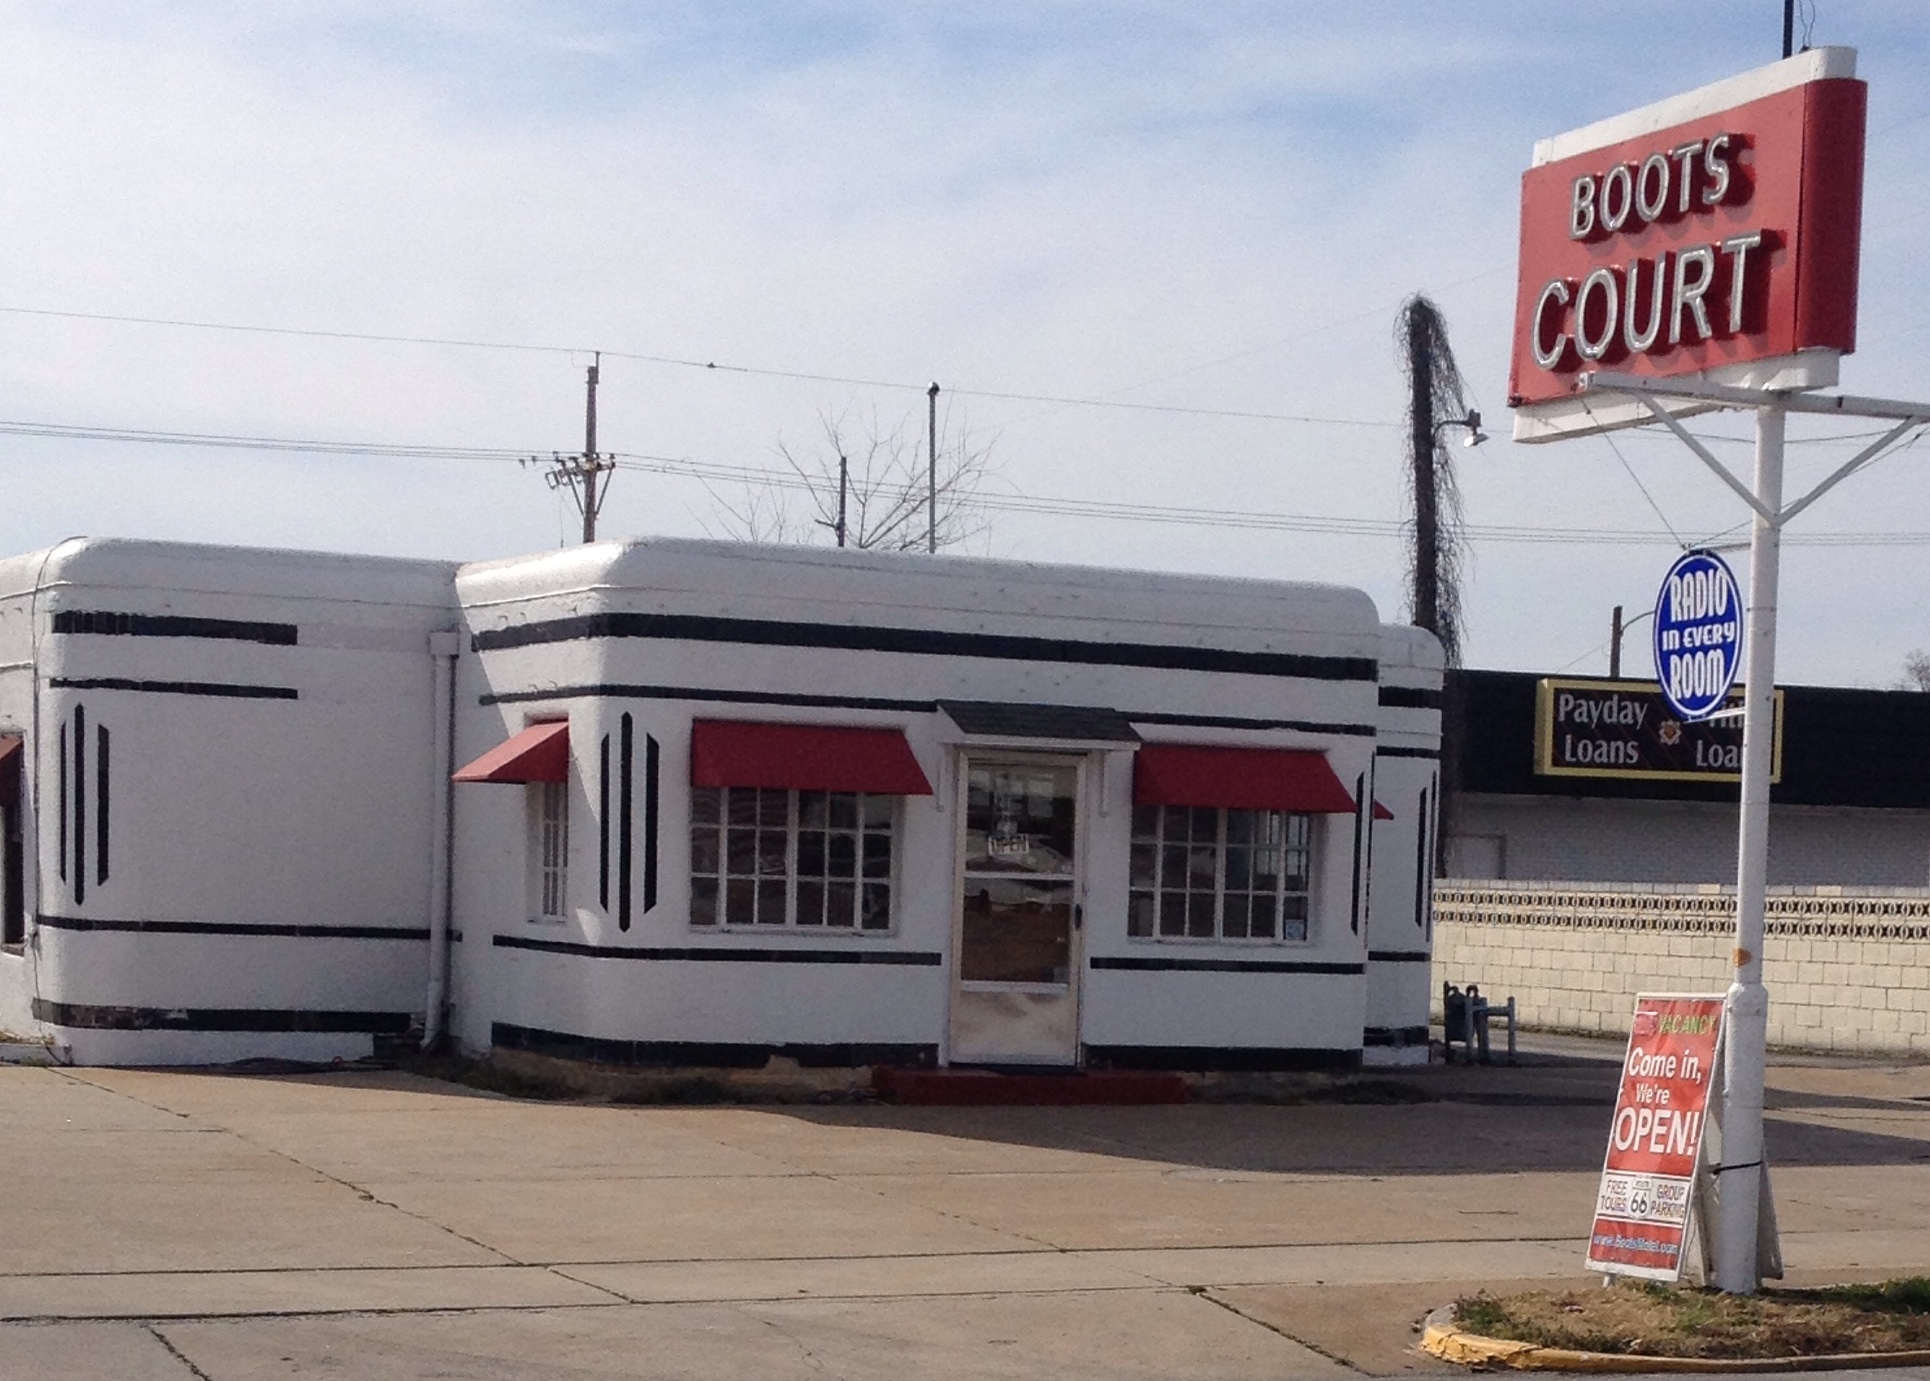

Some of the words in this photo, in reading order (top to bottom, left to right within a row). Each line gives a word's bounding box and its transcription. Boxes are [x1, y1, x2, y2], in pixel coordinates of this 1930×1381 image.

[1571, 134, 1730, 240] BOOTS
[1530, 230, 1761, 371] COURT
[1670, 567, 1728, 623] RADIO
[1683, 621, 1735, 648] EVERY
[1669, 648, 1725, 699] ROOM
[1558, 693, 1648, 730] Payday
[1564, 734, 1639, 764] Loans
[1696, 739, 1744, 767] Loa
[1658, 1013, 1717, 1036] VACANCY
[1628, 1047, 1676, 1078] Come
[1680, 1049, 1702, 1083] in,
[1636, 1083, 1670, 1104] We're
[1614, 1107, 1700, 1157] OPEN!
[1600, 1194, 1627, 1212] TOURS
[1606, 1179, 1628, 1196] FREE
[1630, 1191, 1648, 1214] 66
